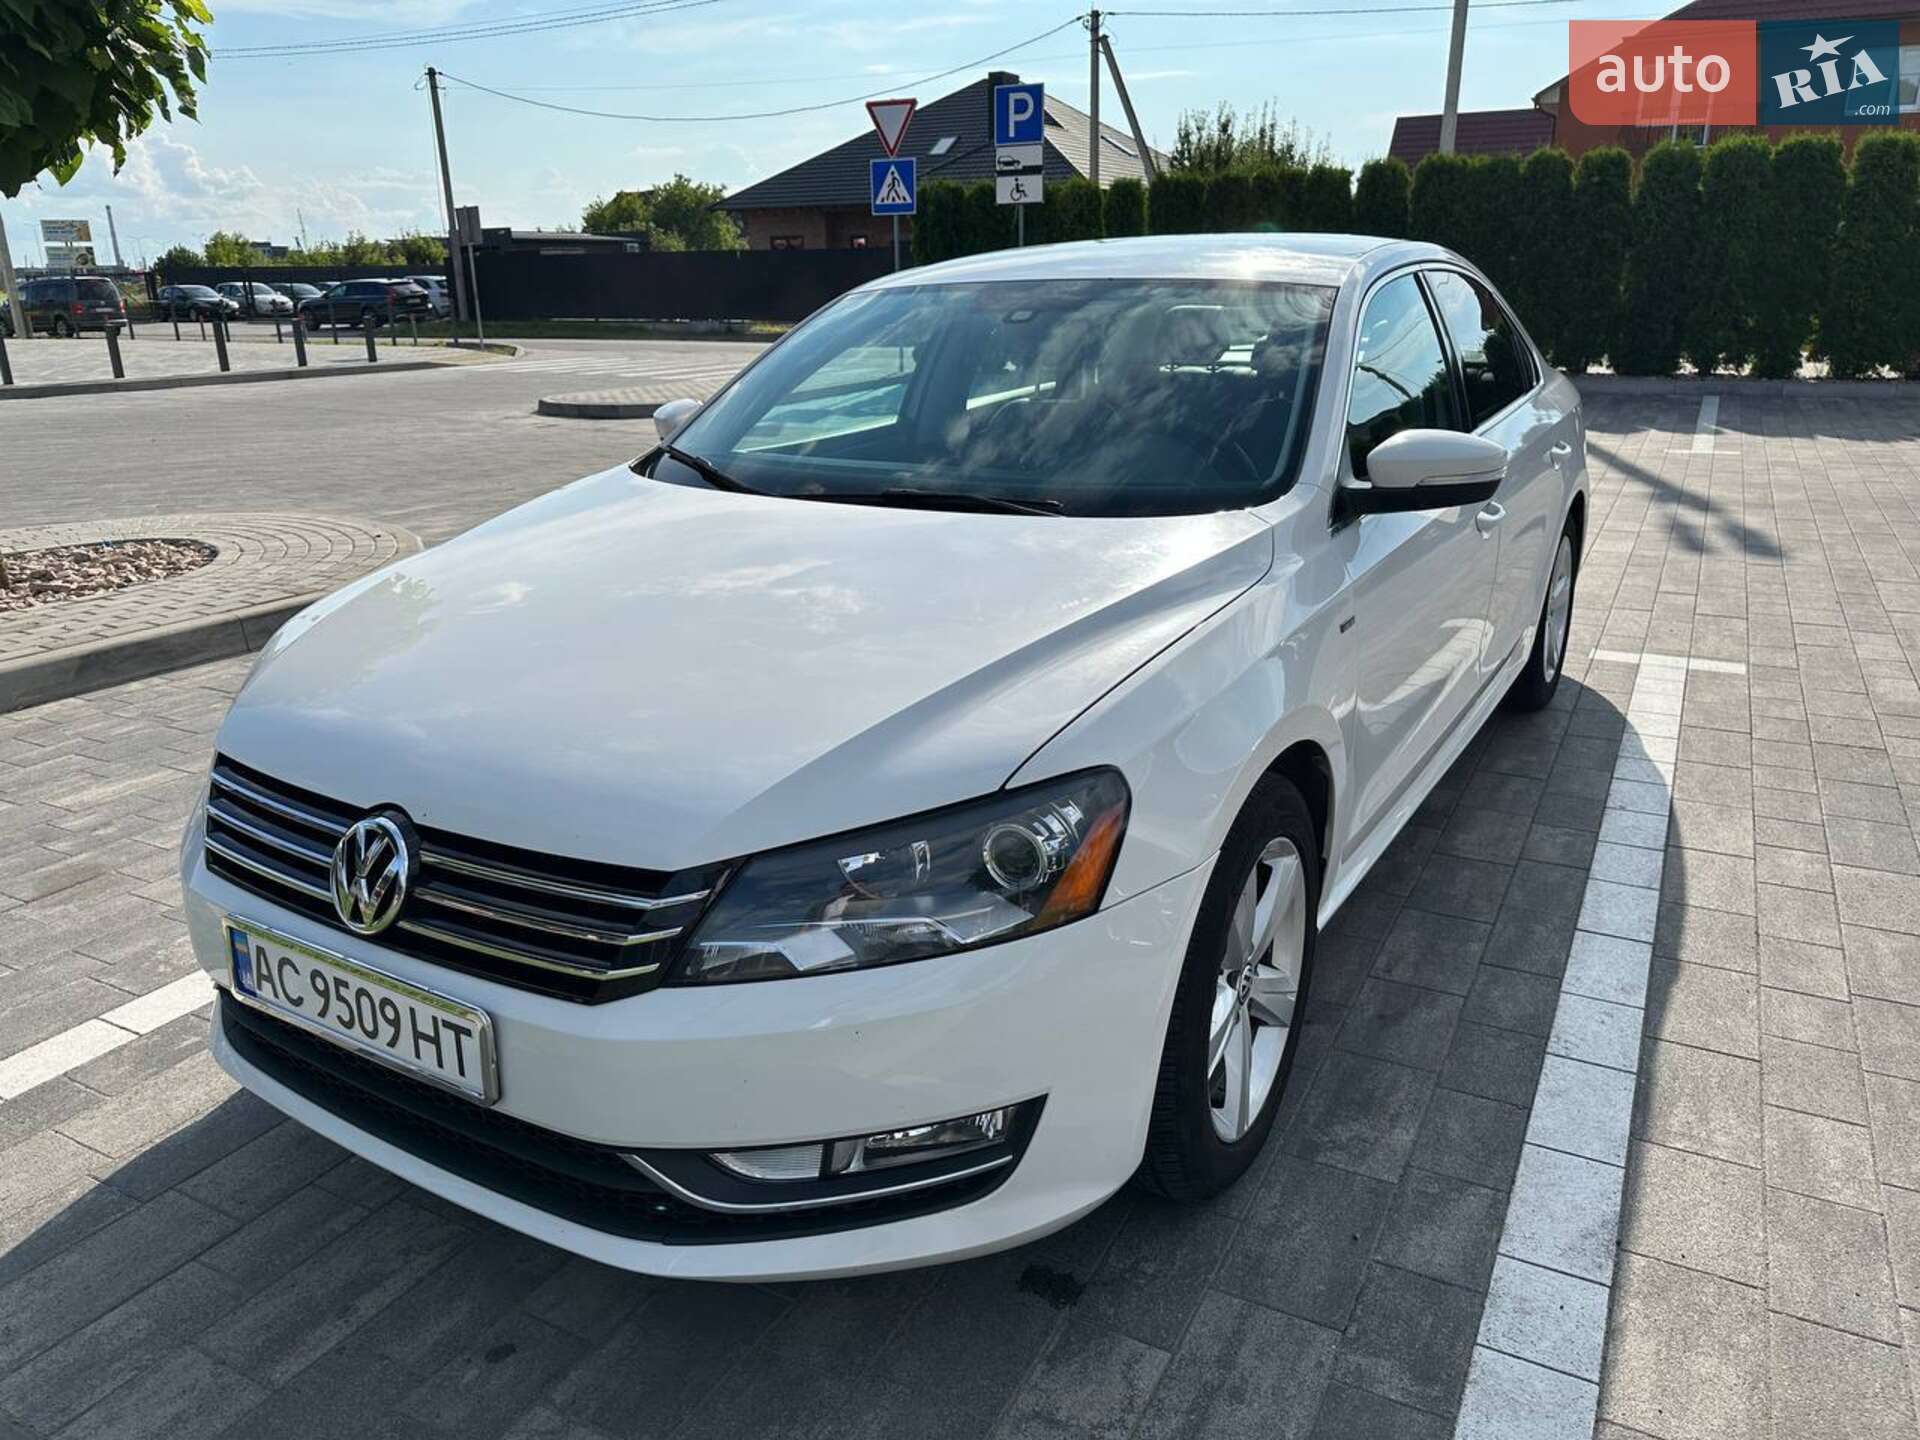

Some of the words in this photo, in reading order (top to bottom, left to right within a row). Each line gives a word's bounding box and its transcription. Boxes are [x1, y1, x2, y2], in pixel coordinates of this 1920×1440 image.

[1008, 92, 1034, 138] P
[331, 817, 408, 935] VW
[255, 945, 304, 1008] AC
[310, 969, 401, 1049] 9509
[409, 1006, 472, 1078] HT
